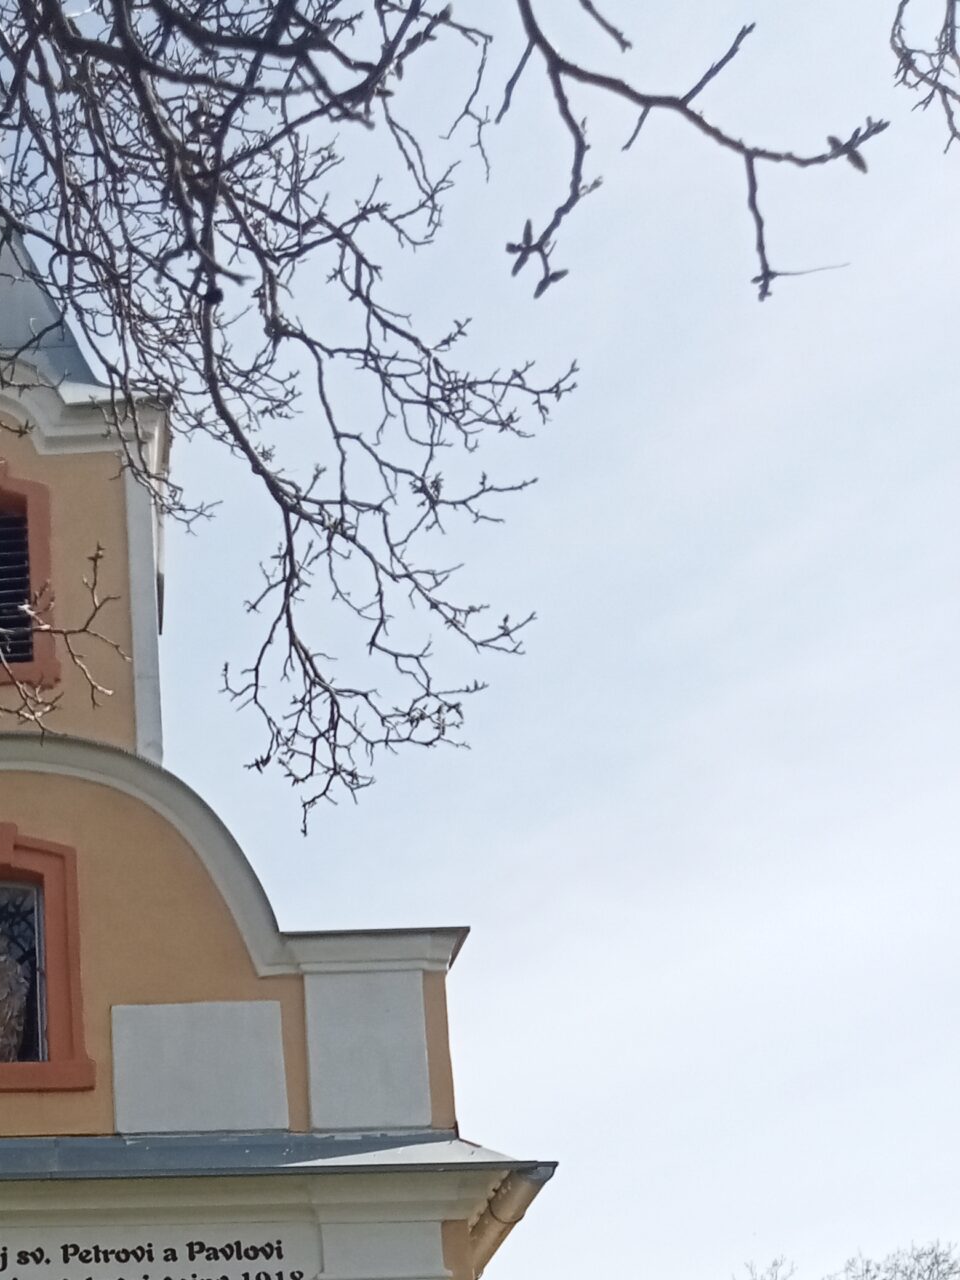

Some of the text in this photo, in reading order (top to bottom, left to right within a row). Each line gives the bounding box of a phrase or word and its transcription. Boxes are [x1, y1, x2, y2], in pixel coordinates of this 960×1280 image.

[15, 1246, 51, 1266] sv.
[60, 1242, 155, 1264] Petrovi
[162, 1245, 178, 1262] a
[186, 1239, 284, 1261] Pavlovi
